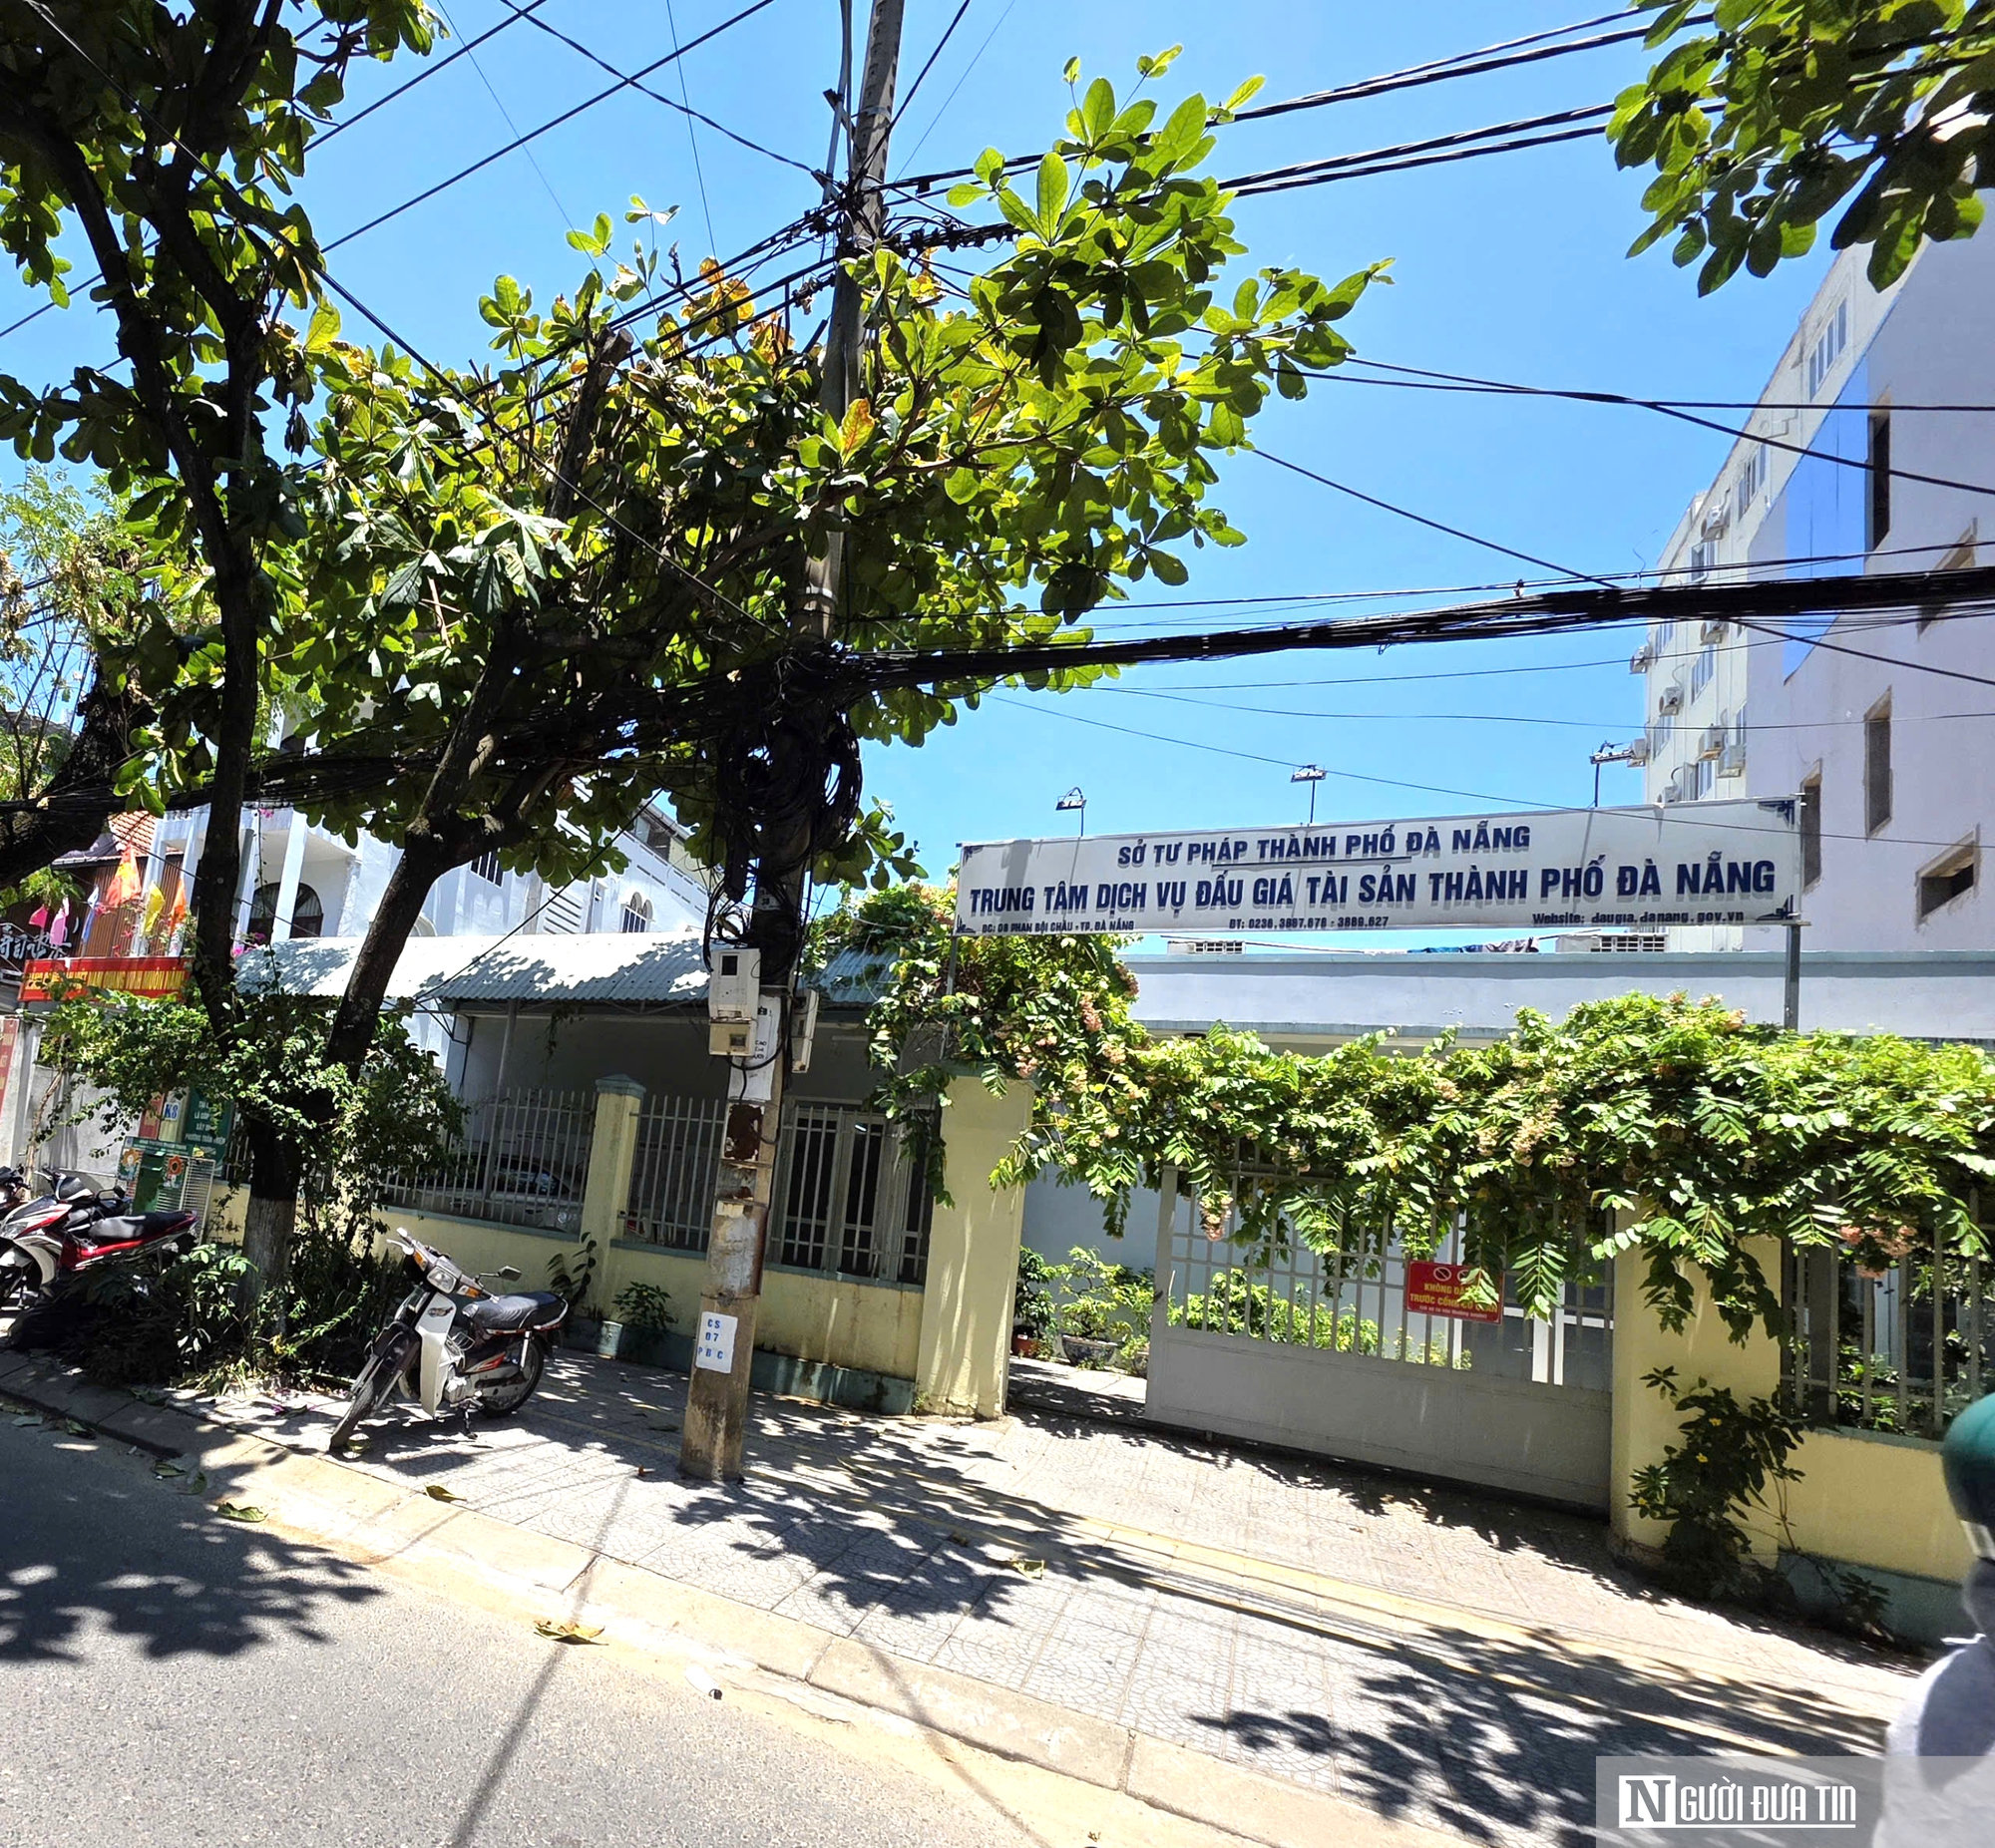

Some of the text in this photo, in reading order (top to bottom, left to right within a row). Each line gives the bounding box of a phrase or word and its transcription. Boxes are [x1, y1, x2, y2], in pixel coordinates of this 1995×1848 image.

[1118, 820, 1530, 865] SỞ TƯ PHÁP THÀNH PHỐ ĐÀ NẴNG
[971, 851, 1776, 915] TRUNG TÂM DỊCH VỤ ĐẤU GIÁ TÀI SẢN THÀNH PHỐ ĐÀ NẴNG
[1532, 912, 1585, 924] Website:
[1010, 922, 1032, 933] PHAN
[164, 1103, 179, 1119] K8
[1424, 1283, 1468, 1296] KHÔNG ĐẬ
[1410, 1293, 1435, 1304] TRƯỚC
[707, 1318, 720, 1329] CS
